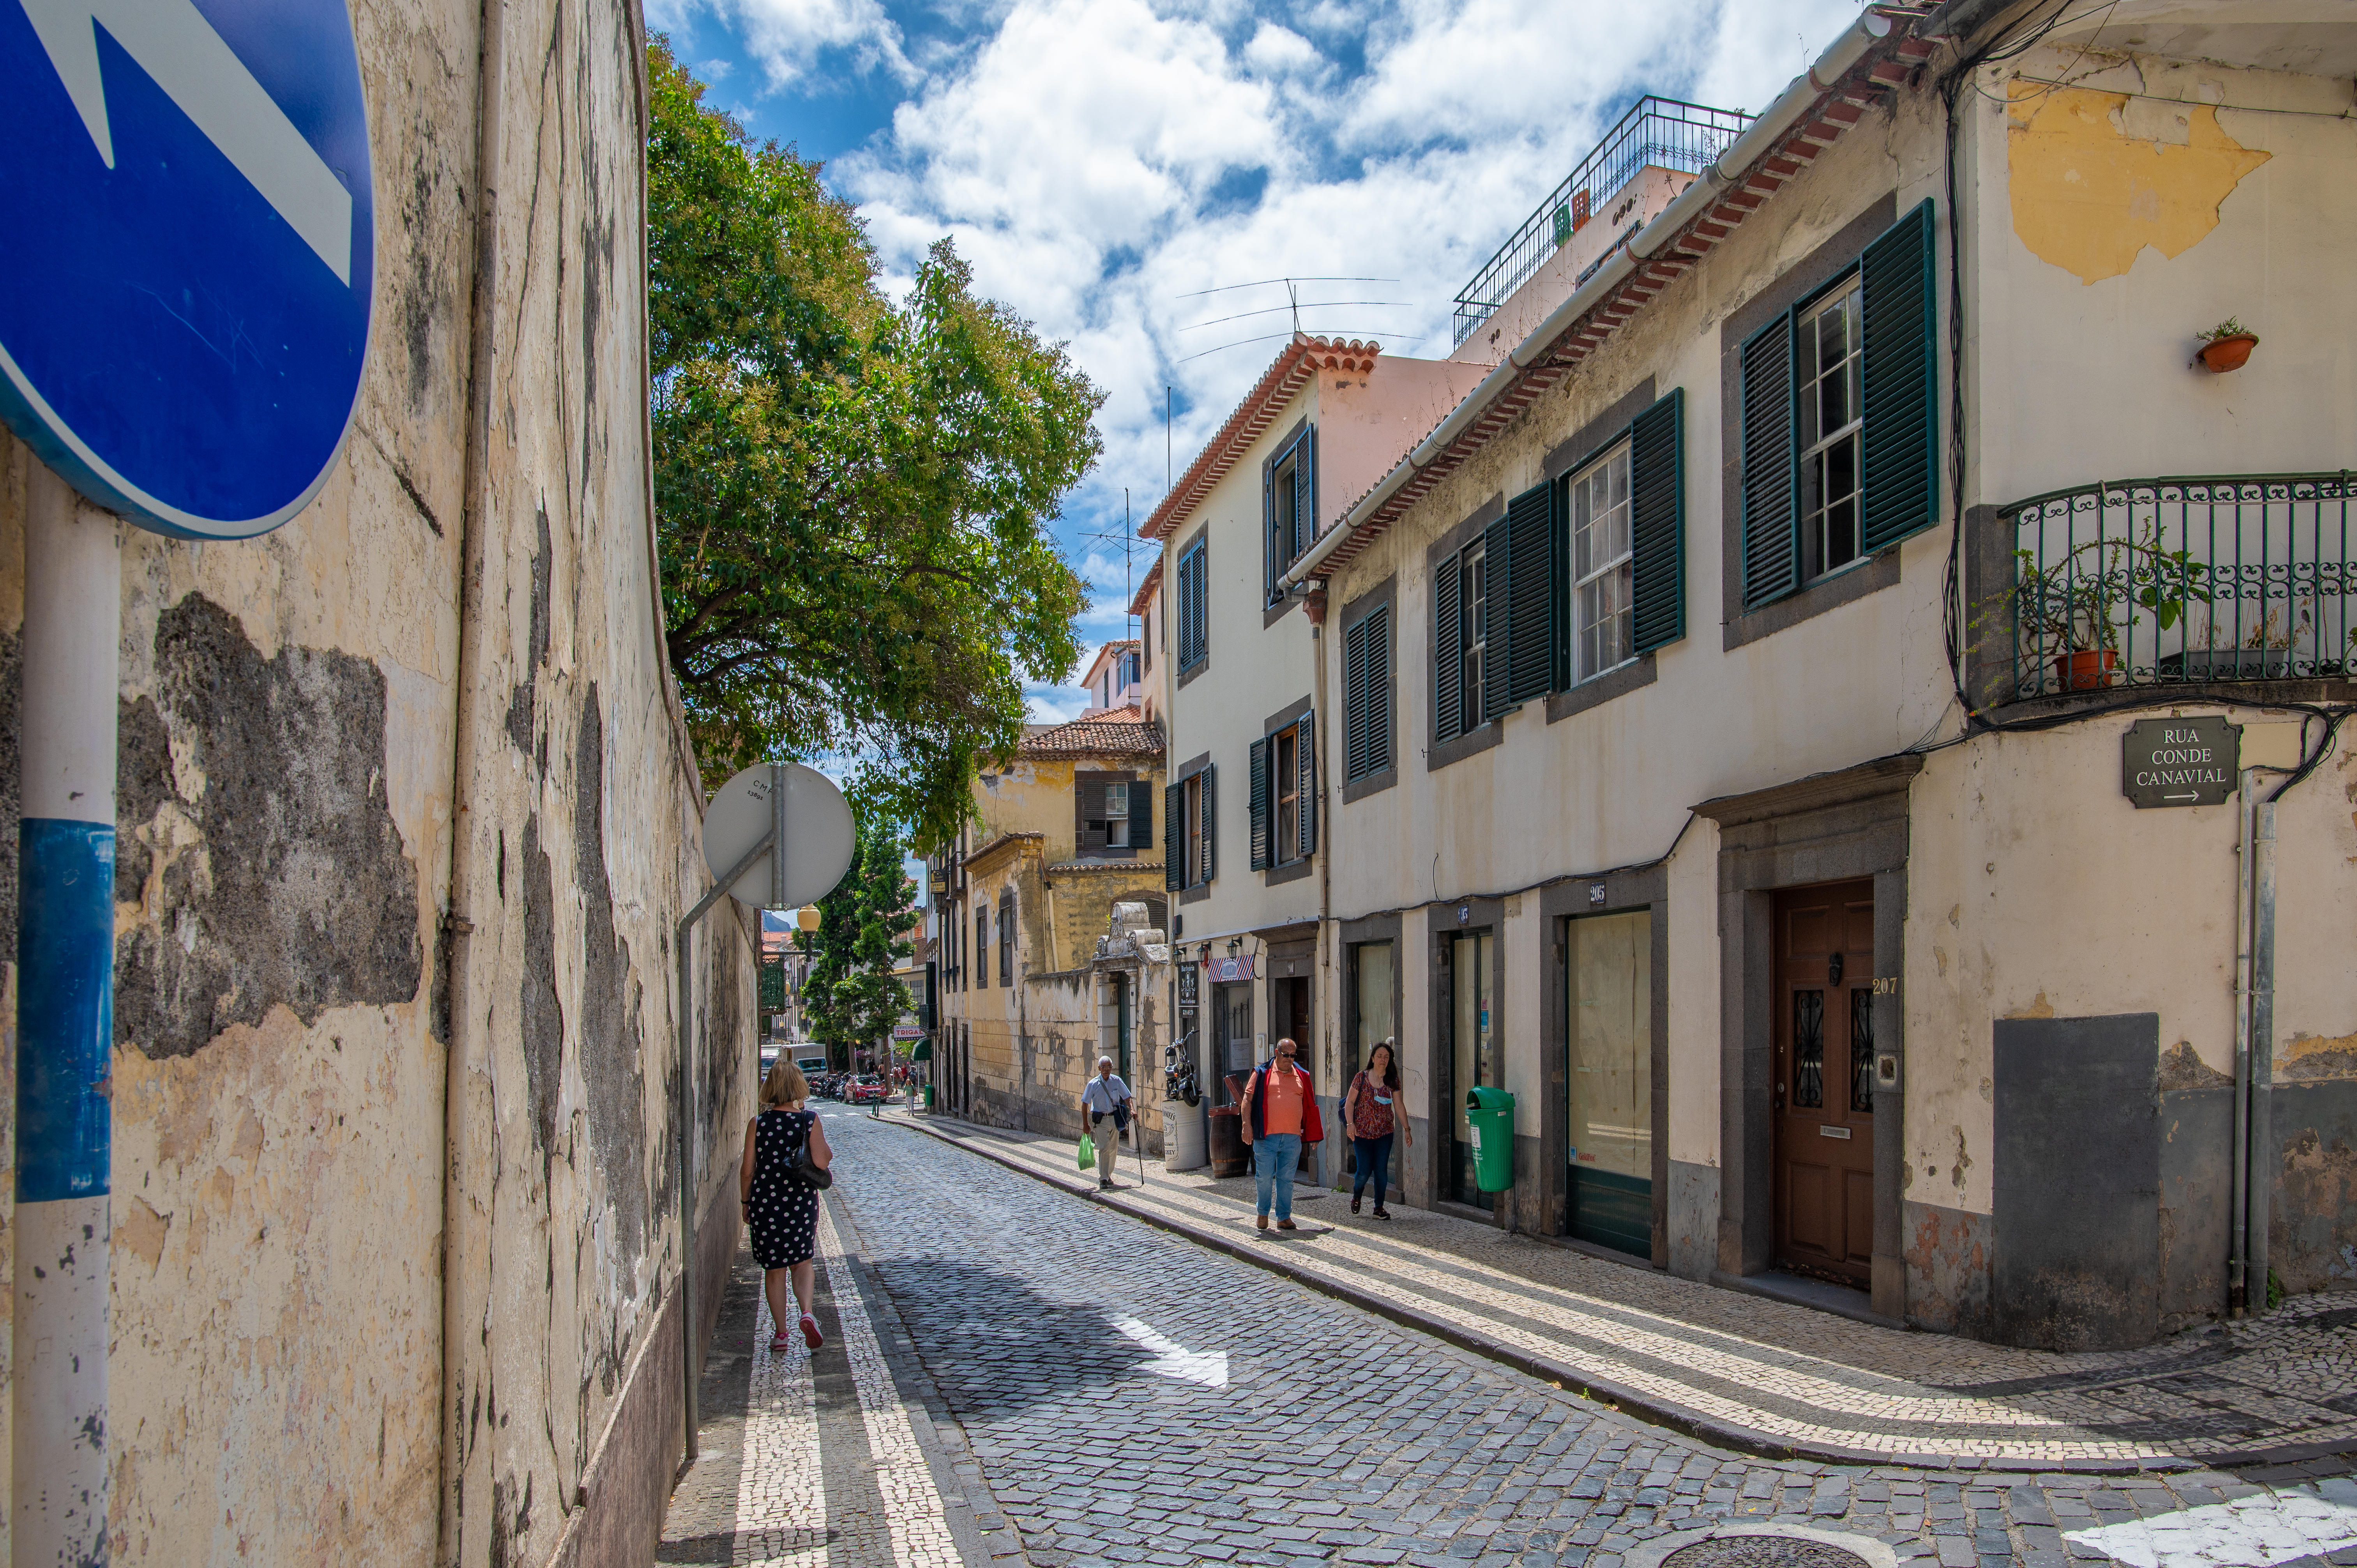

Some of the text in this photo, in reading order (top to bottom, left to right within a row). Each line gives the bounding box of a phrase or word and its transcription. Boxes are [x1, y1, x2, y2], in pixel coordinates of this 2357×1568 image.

[2163, 729, 2199, 743] RUA
[2152, 749, 2211, 764] CONDE
[2136, 768, 2226, 786] CANAVIAL
[747, 790, 763, 800] 13891
[1590, 885, 1604, 901] 205
[1873, 977, 1898, 994] 207
[1579, 1153, 1595, 1162] GoldFox
